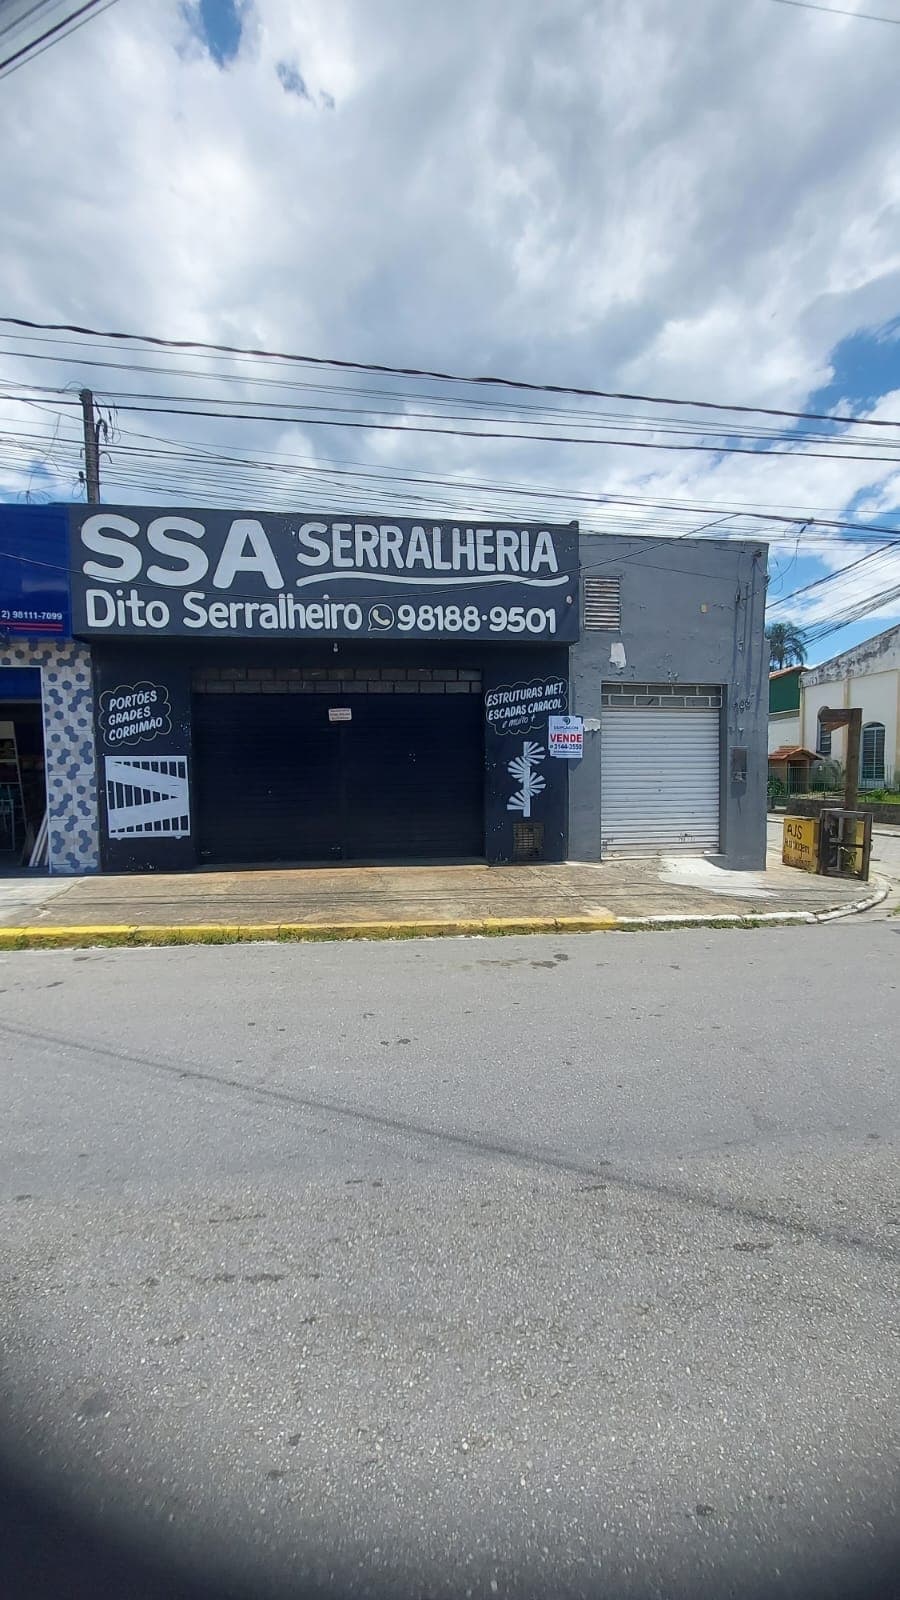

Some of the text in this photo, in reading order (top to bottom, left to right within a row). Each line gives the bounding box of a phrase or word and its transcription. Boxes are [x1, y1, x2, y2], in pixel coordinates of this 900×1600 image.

[80, 513, 559, 590] SSA SERRALHERIA
[85, 588, 170, 629] Dito
[182, 591, 363, 630] Serralheiro
[109, 690, 158, 712] PORTÕES
[487, 681, 564, 707] ESTRUTURAS MET.
[108, 705, 151, 726] GRADES
[488, 698, 562, 721] ESCADAS CARACOL
[108, 716, 163, 741] CORRIMÃO
[550, 733, 583, 743] VENDE
